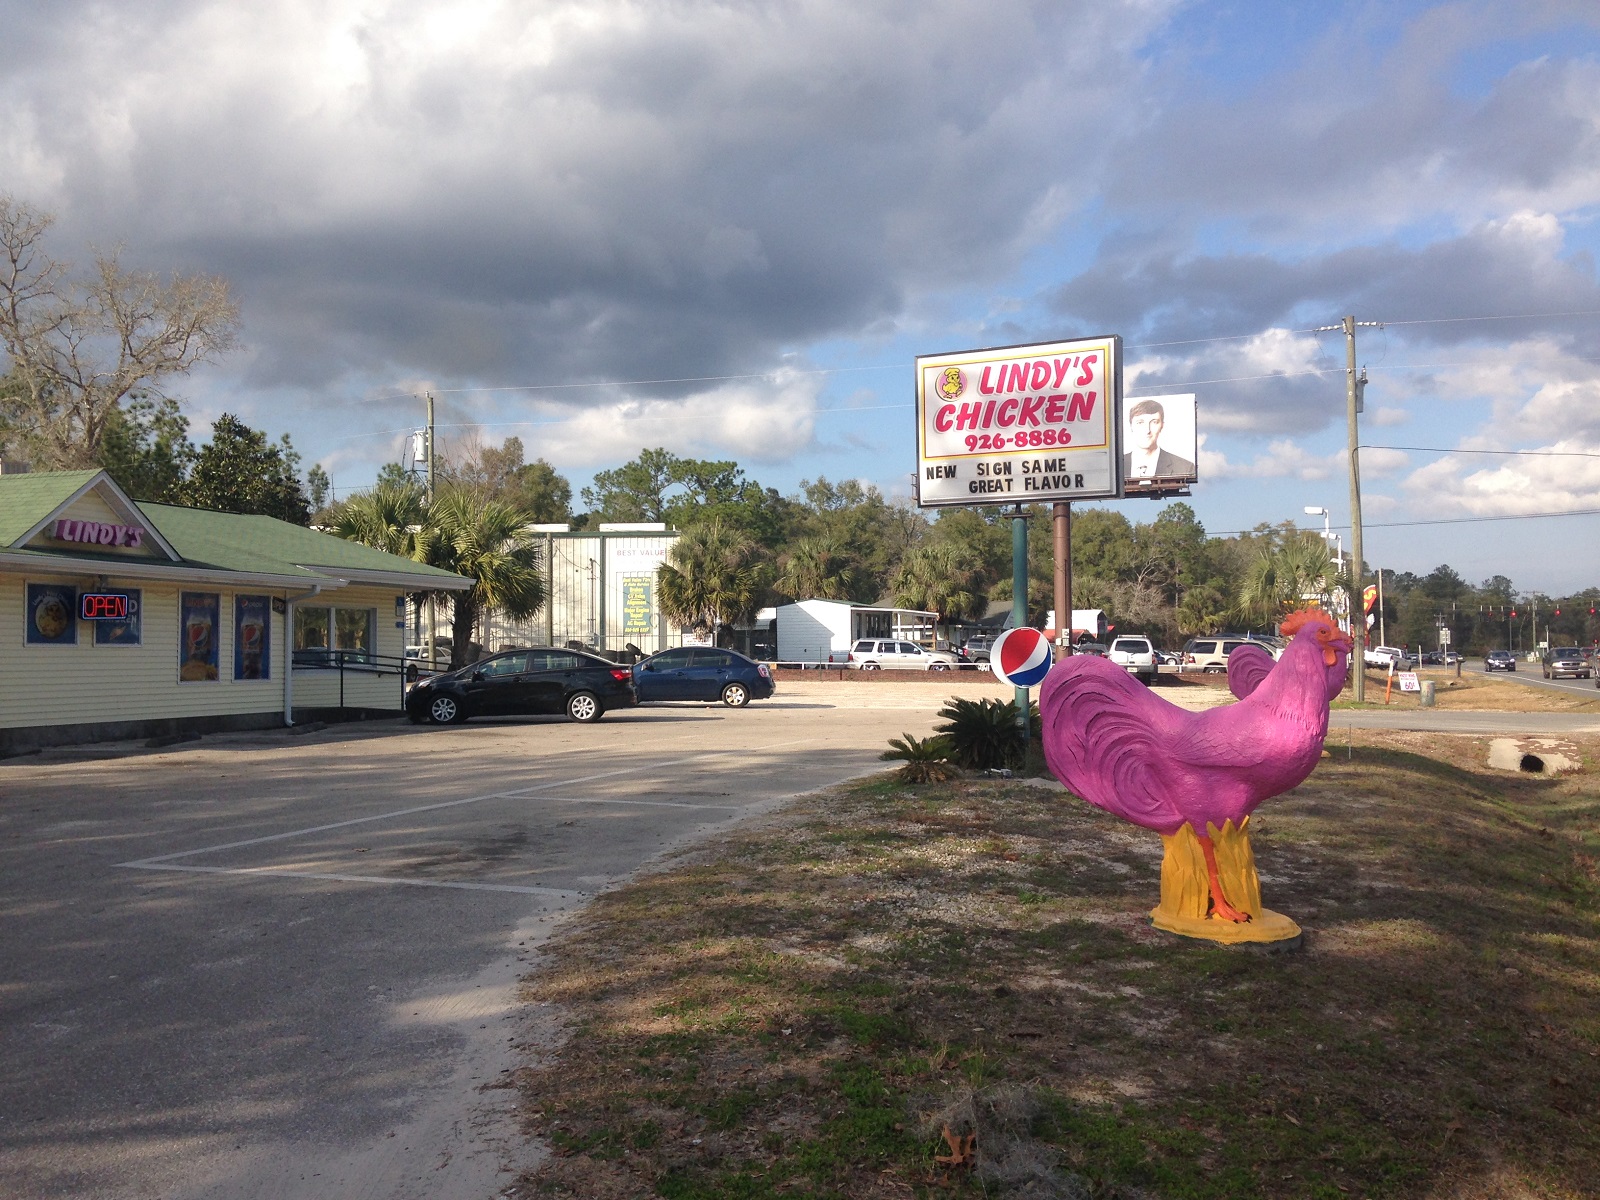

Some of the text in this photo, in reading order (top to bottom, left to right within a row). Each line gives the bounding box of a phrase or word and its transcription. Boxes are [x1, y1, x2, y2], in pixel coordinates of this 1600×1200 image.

[979, 354, 1098, 395] LINDY'S
[935, 391, 1097, 433] CHICKEN
[964, 428, 1072, 451] 926-8886
[926, 458, 1066, 480] NEW SIGN SAME
[968, 474, 1084, 494] GREAT FLAVOR
[61, 519, 145, 548] LINDY'S
[616, 549, 637, 557] BEST
[84, 596, 127, 617] OPEN
